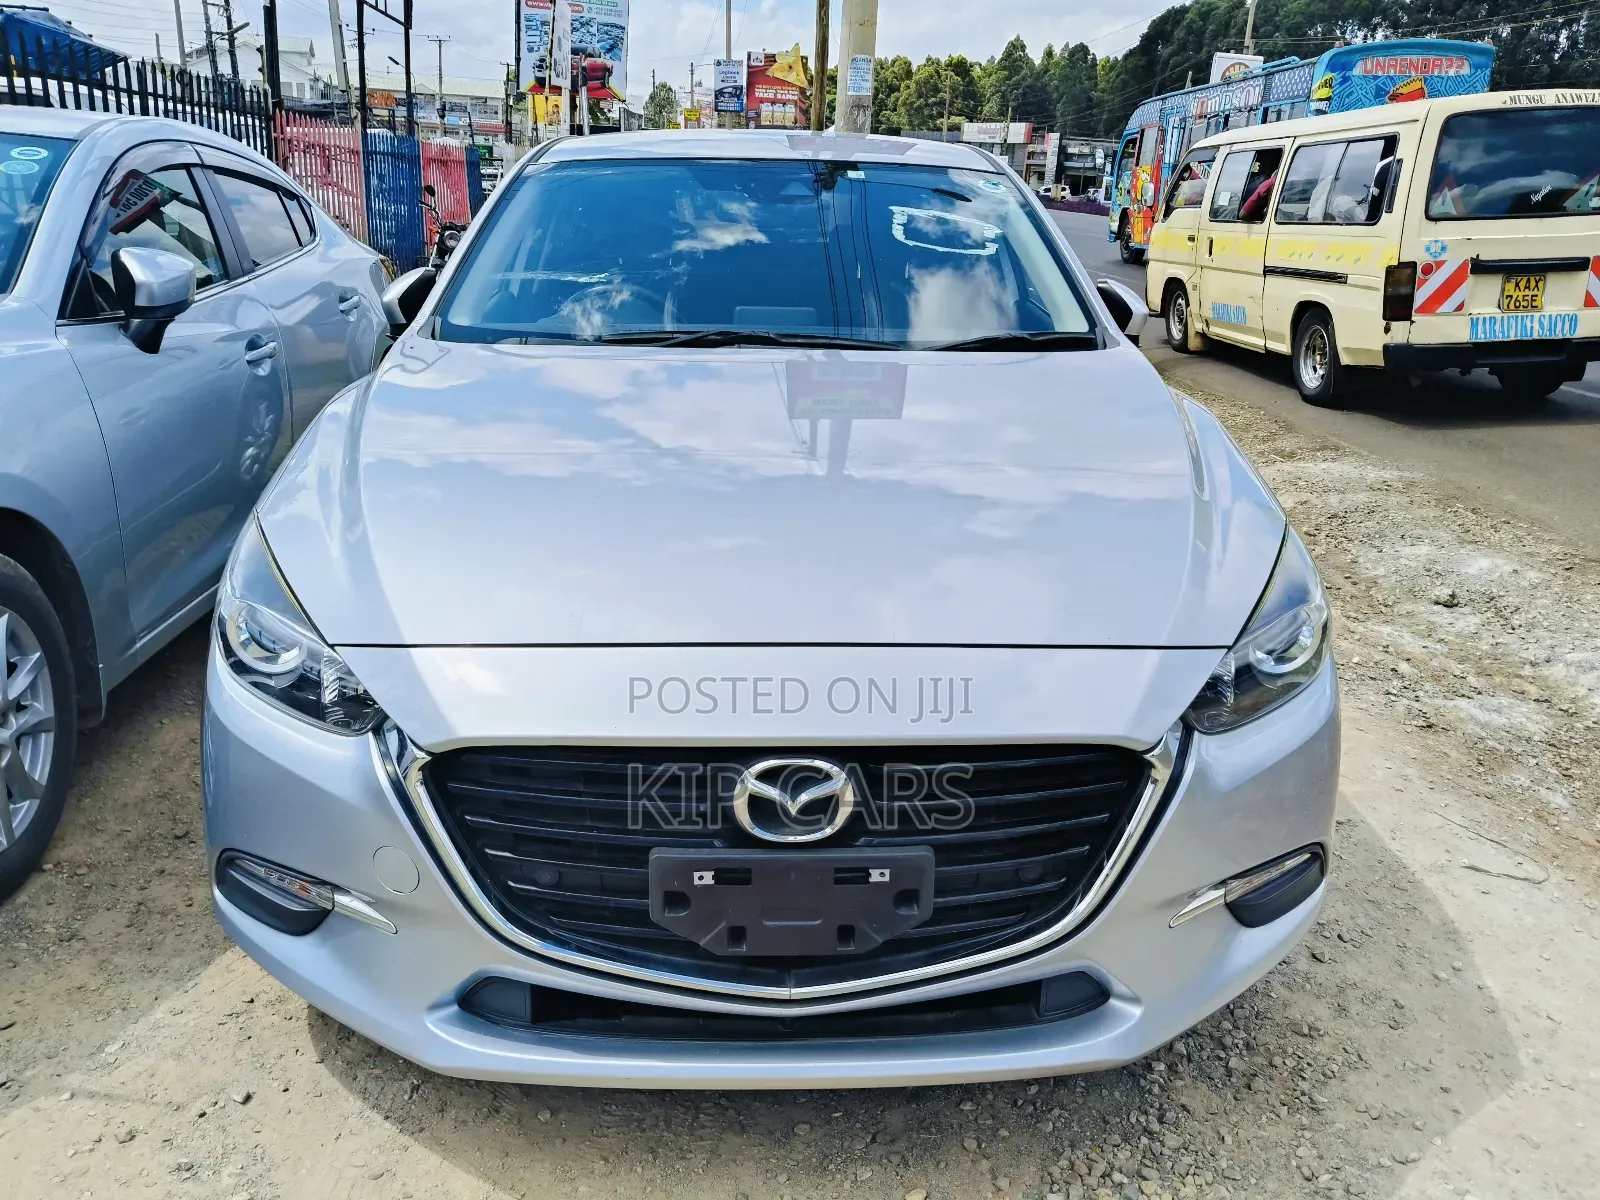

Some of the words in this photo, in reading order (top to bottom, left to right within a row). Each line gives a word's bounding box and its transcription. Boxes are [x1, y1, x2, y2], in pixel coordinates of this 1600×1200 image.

[1508, 93, 1547, 106] MUNGU
[1513, 277, 1541, 292] KAX
[1505, 294, 1539, 310] 765E
[1468, 314, 1535, 341] MARAFIKI
[1537, 312, 1579, 338] SACCO
